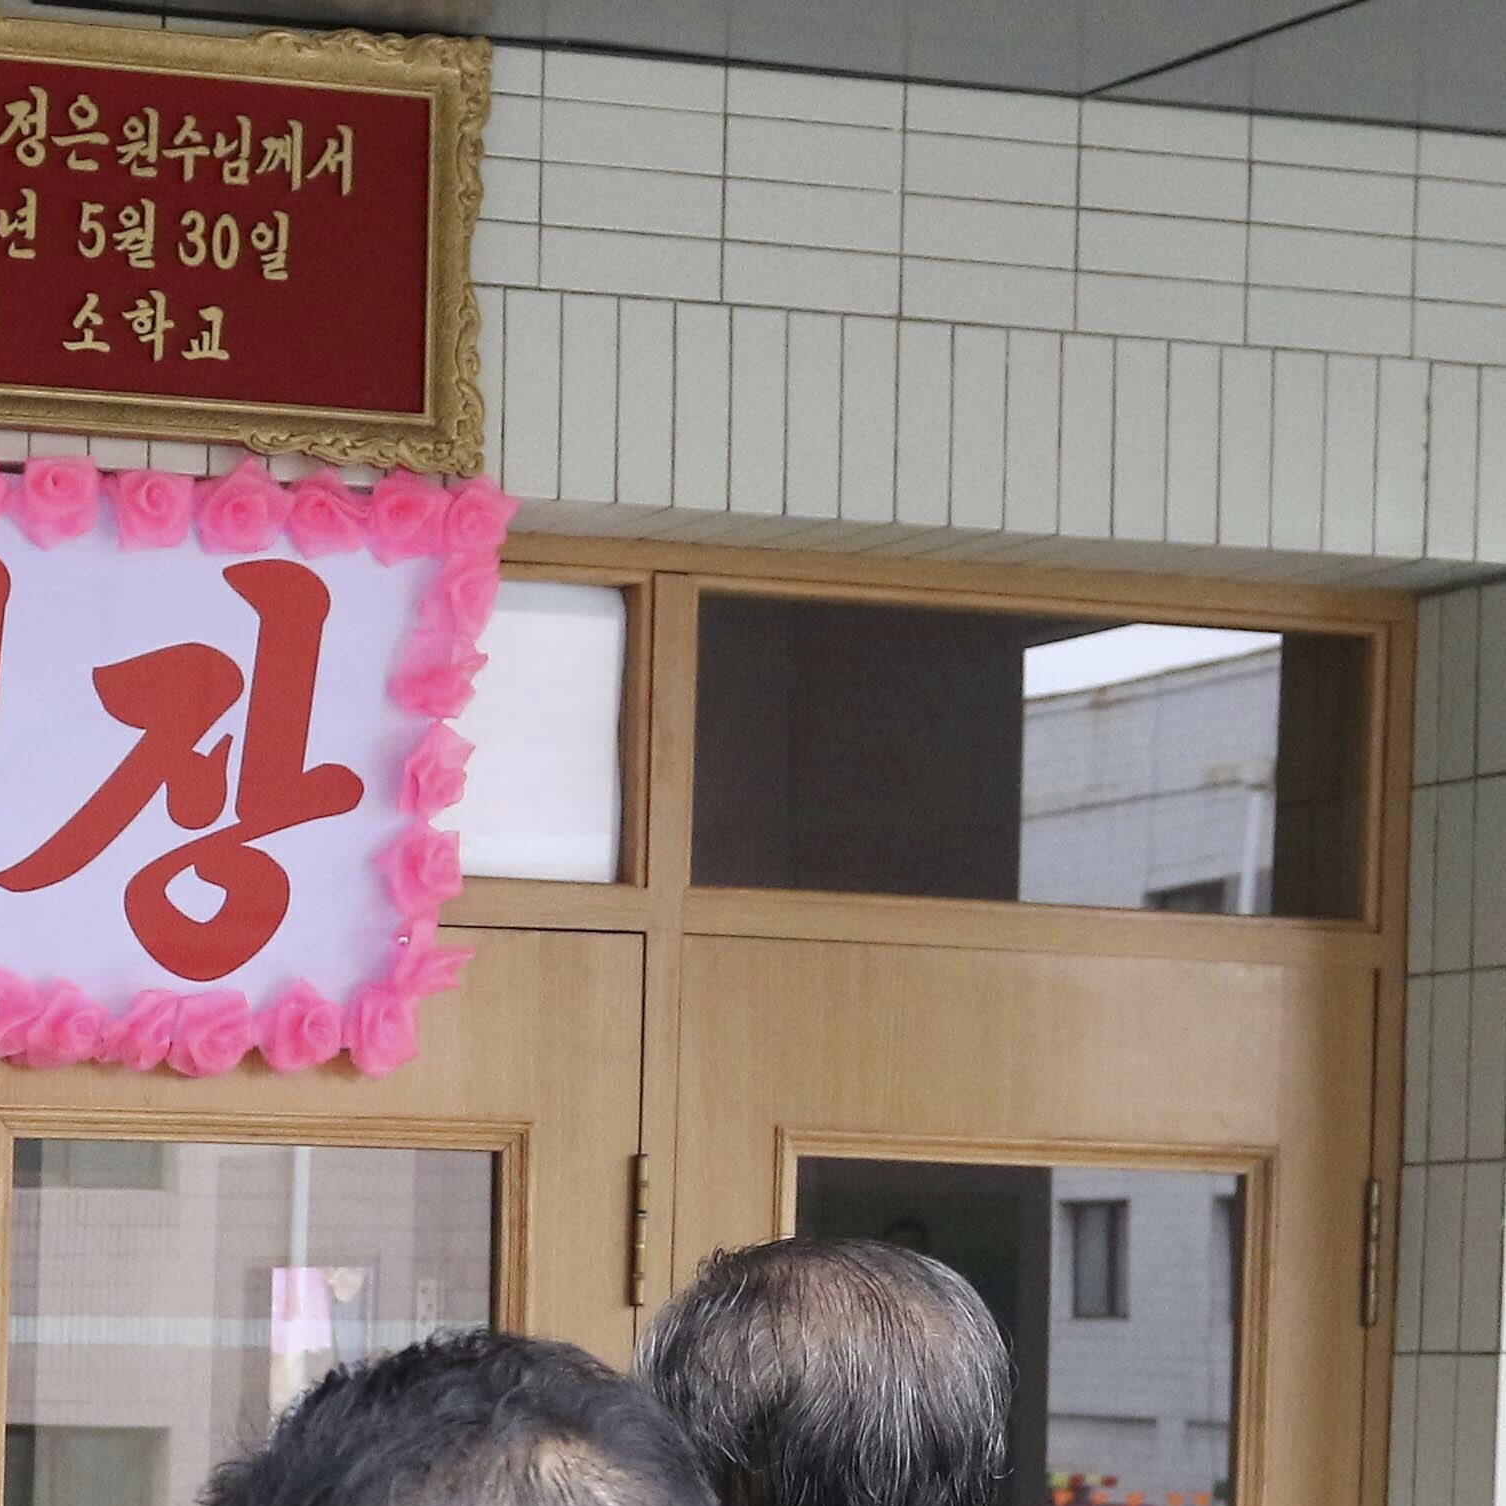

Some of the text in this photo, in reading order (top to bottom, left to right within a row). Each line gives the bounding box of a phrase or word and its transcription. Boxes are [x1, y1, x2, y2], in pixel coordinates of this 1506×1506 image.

[78, 197, 156, 270] 5월
[178, 209, 291, 281] 30일
[61, 290, 232, 363] 소학교
